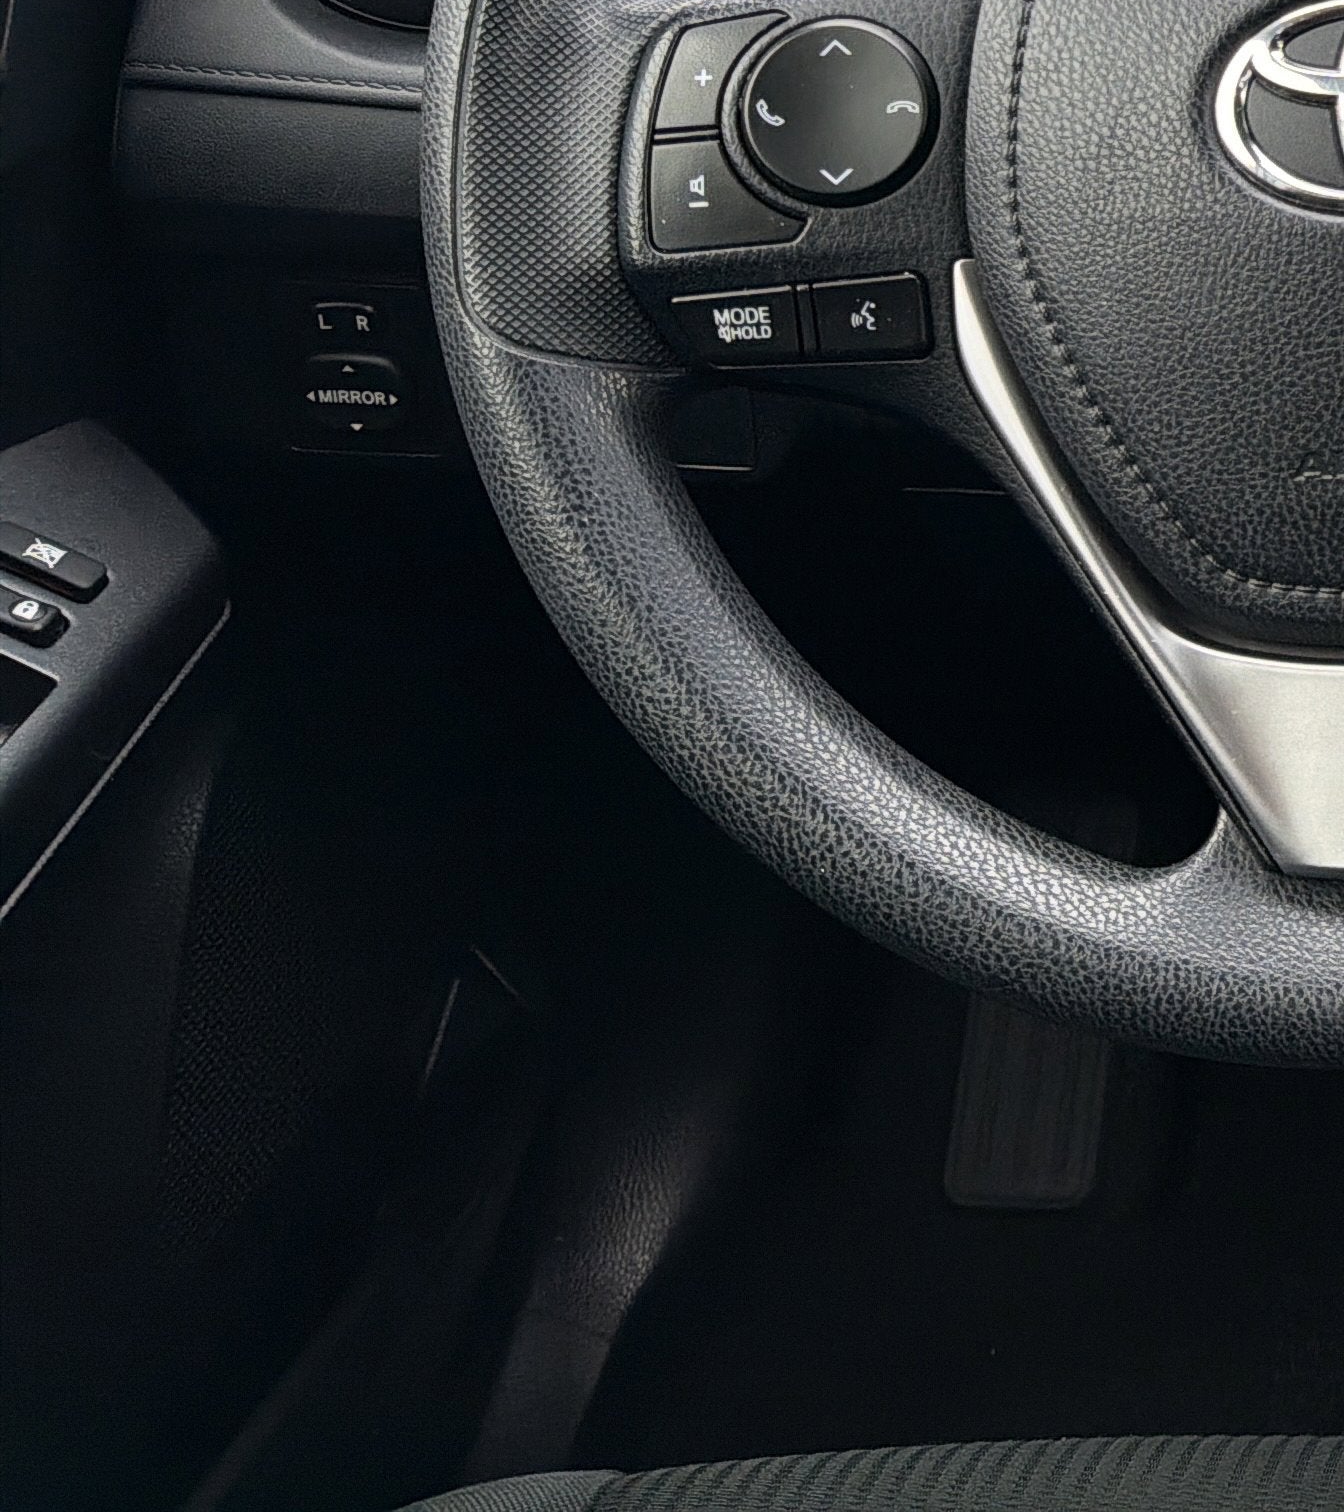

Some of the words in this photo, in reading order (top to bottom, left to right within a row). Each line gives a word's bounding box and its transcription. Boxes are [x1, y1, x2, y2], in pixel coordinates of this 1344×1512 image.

[318, 314, 332, 330] L
[355, 315, 371, 332] R
[713, 307, 771, 325] MODE
[732, 325, 773, 340] HOLD
[318, 390, 387, 406] MIRROR
